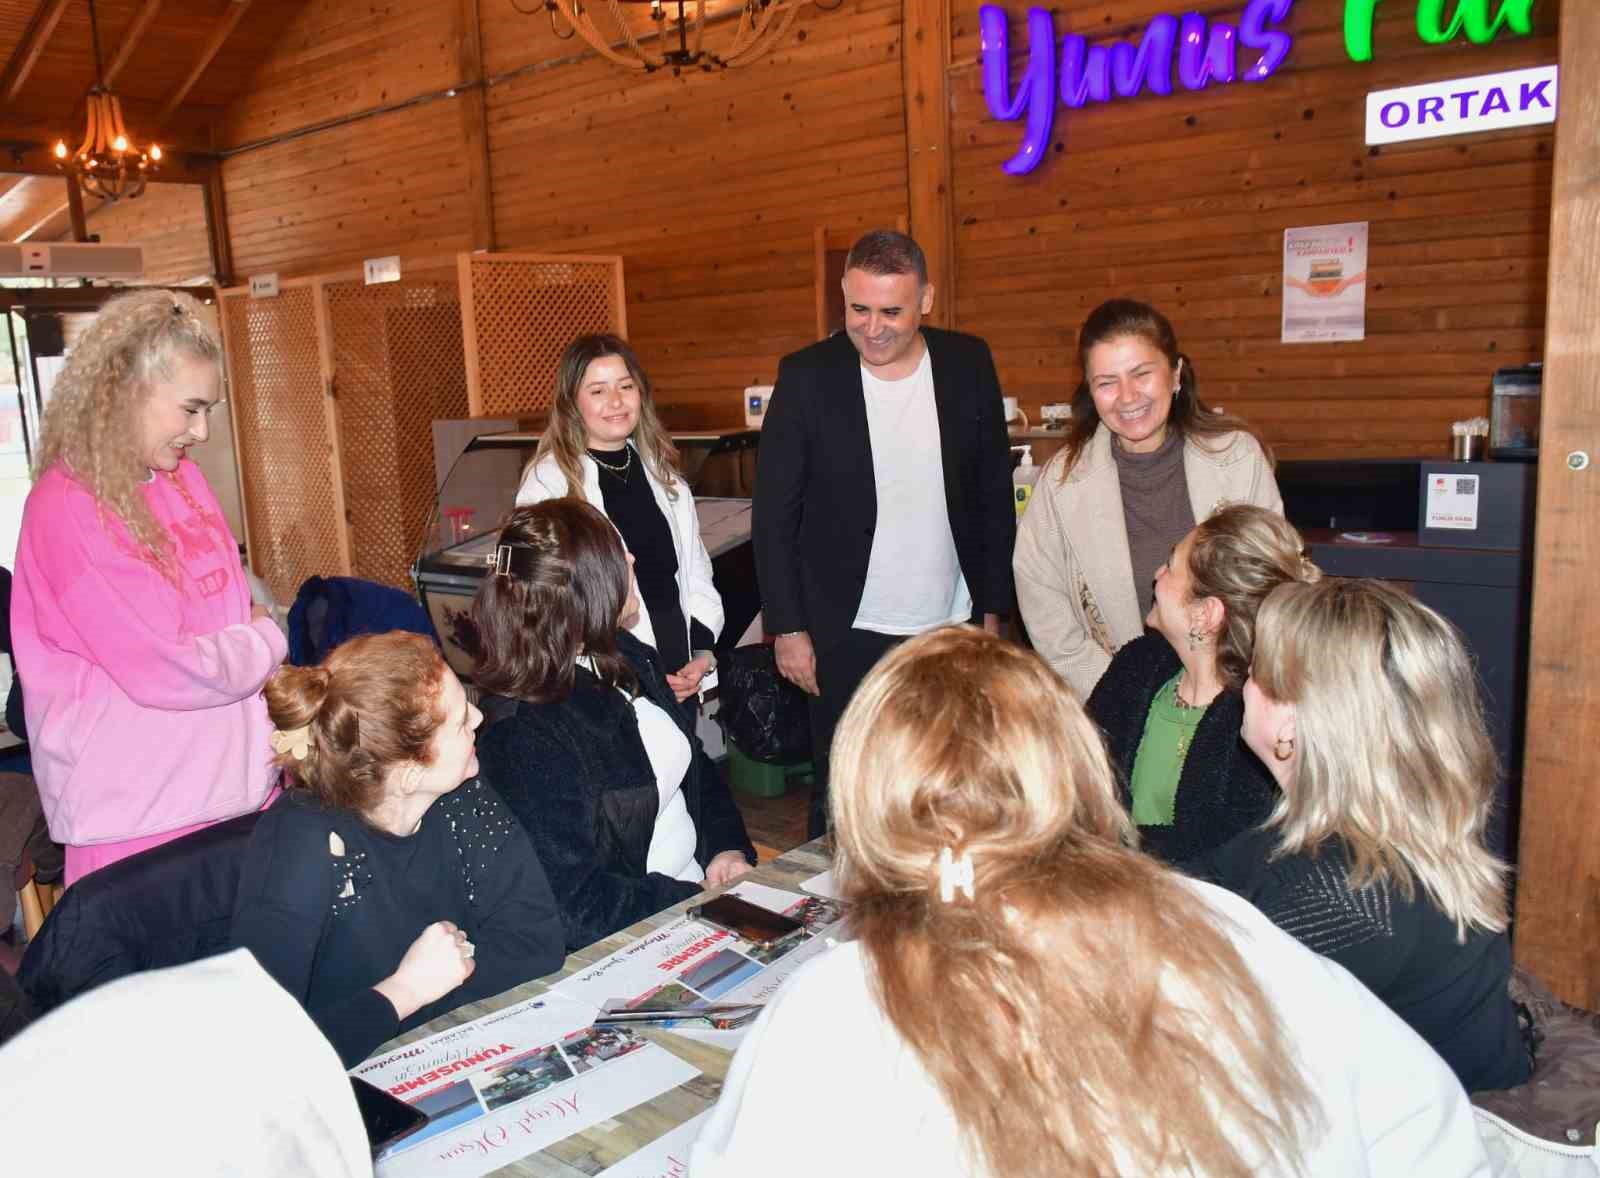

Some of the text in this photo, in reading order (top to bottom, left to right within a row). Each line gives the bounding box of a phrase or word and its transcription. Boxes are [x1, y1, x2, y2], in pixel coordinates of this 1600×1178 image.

[980, 0, 1293, 175] Yunus
[1379, 80, 1553, 129] ORTAK
[359, 1047, 425, 1075] Meydan
[384, 1042, 515, 1096] YUNUSEMR
